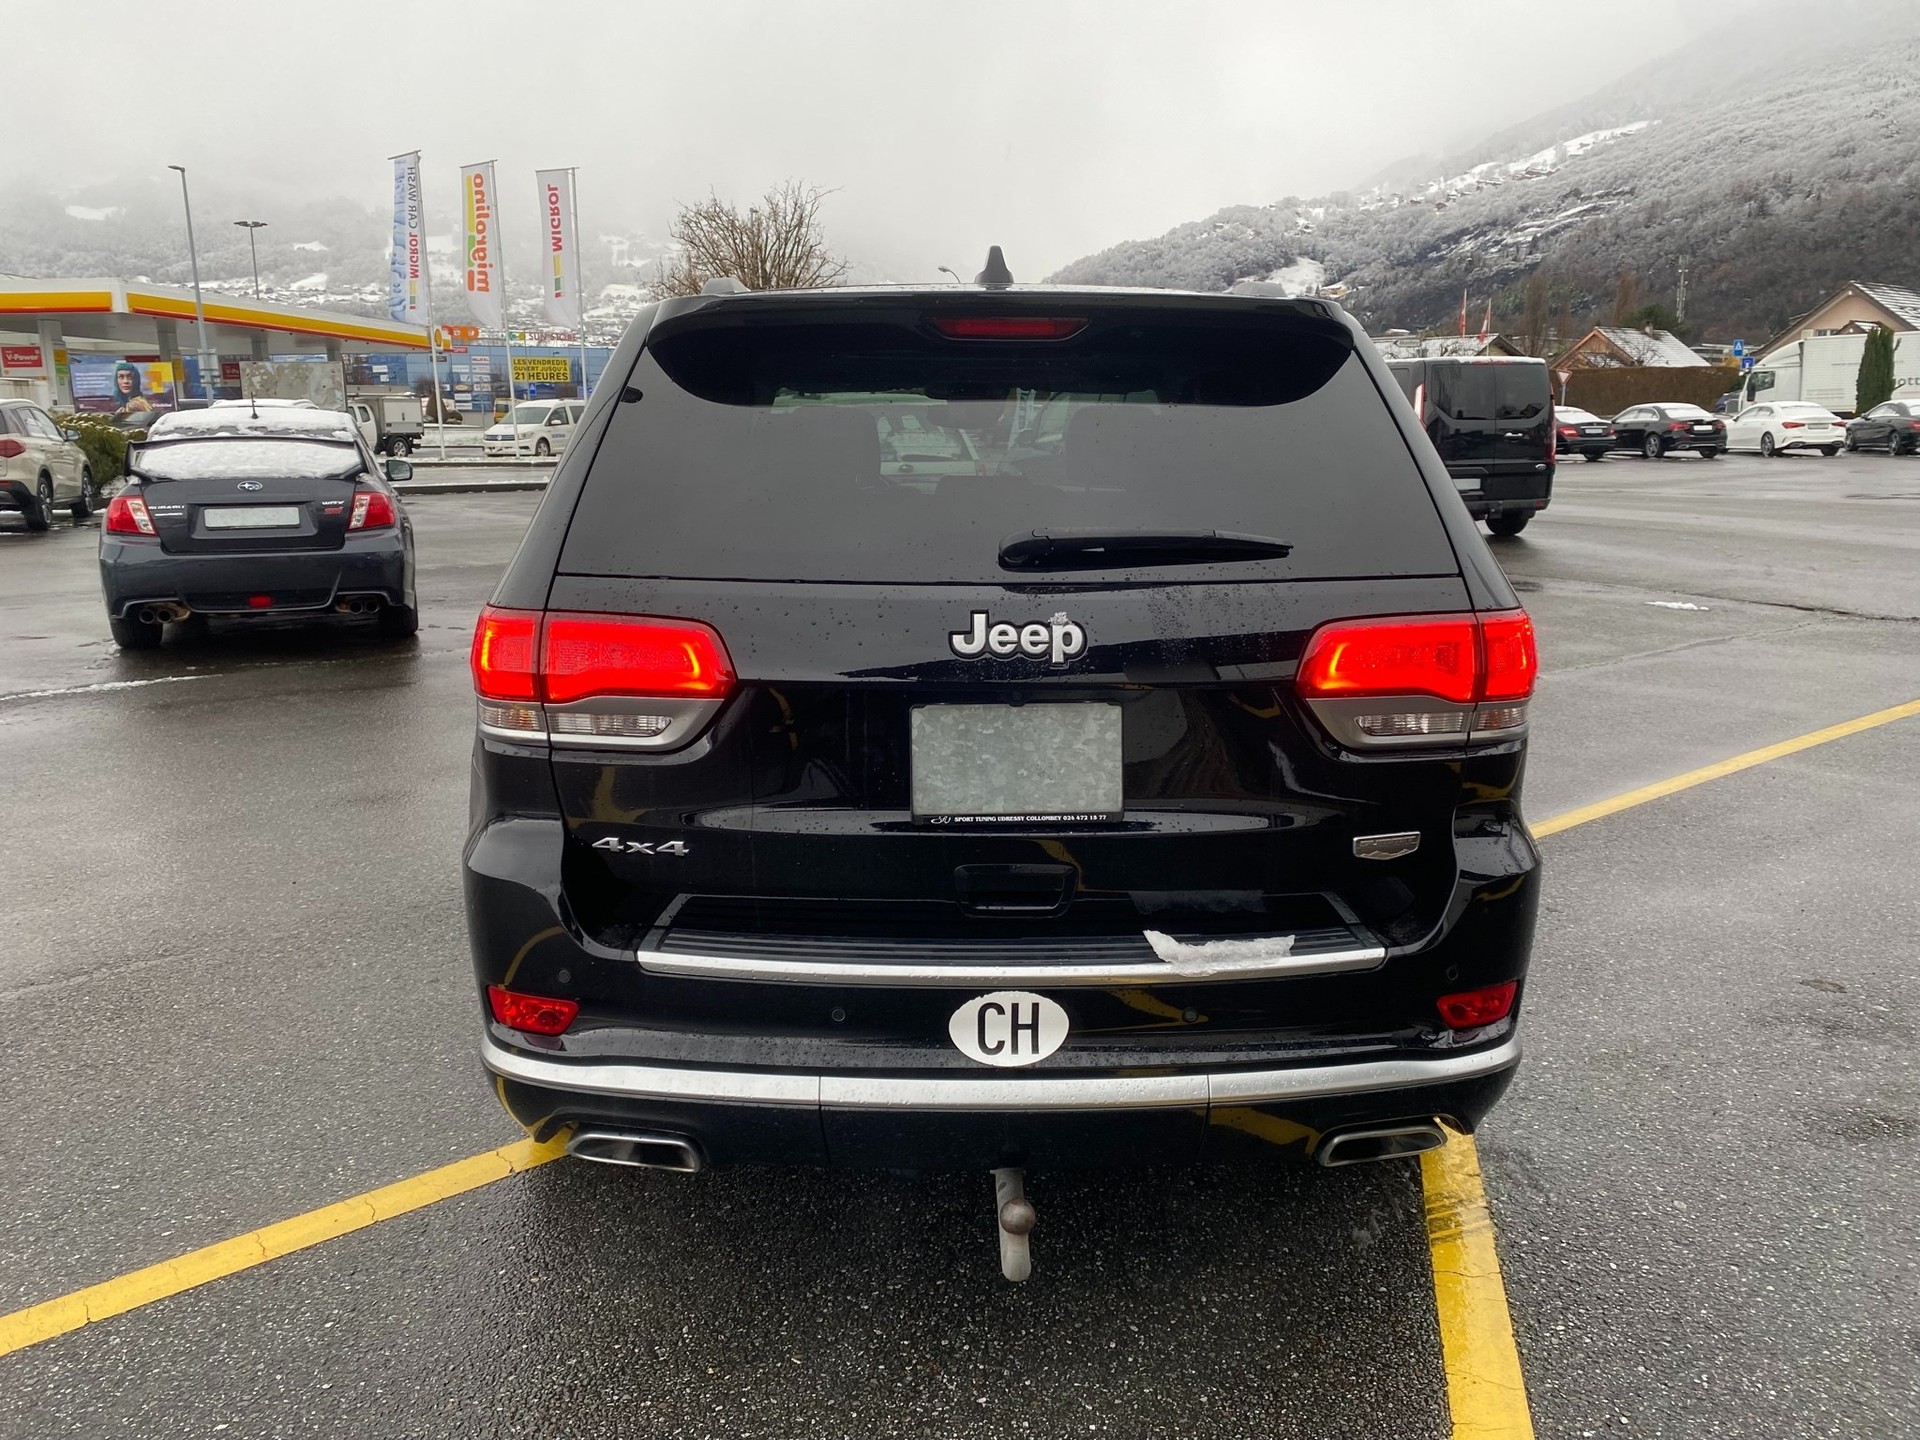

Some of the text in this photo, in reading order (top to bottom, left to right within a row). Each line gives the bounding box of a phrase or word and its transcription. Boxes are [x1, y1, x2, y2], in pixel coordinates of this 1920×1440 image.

[5, 353, 39, 361] V-Power
[513, 358, 568, 366] LES VENDREDIS
[514, 372, 569, 381] 21 HEURES
[950, 611, 1086, 665] Jeep
[592, 837, 690, 857] 4x4
[977, 1002, 1040, 1056] CH
